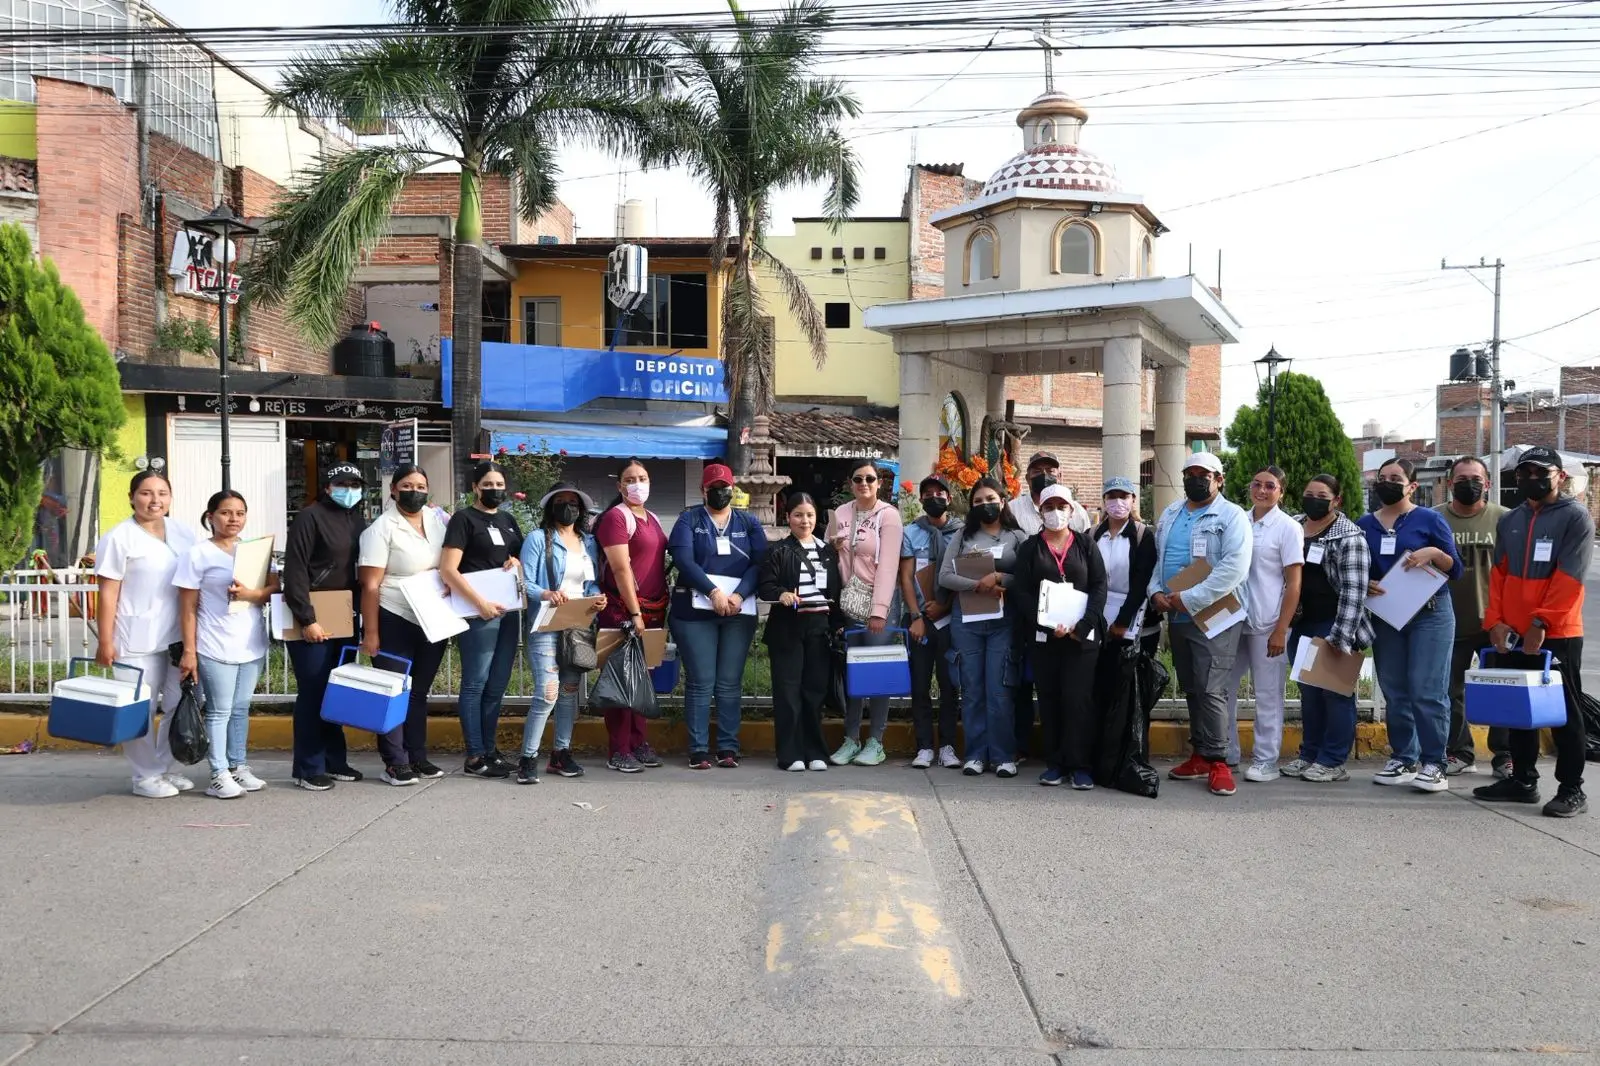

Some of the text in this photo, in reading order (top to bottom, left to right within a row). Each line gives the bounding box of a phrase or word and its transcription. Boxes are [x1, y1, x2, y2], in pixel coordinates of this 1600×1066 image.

[635, 359, 714, 376] DEPOSITO
[620, 376, 726, 398] LA OFICINA
[264, 399, 306, 416] REYES
